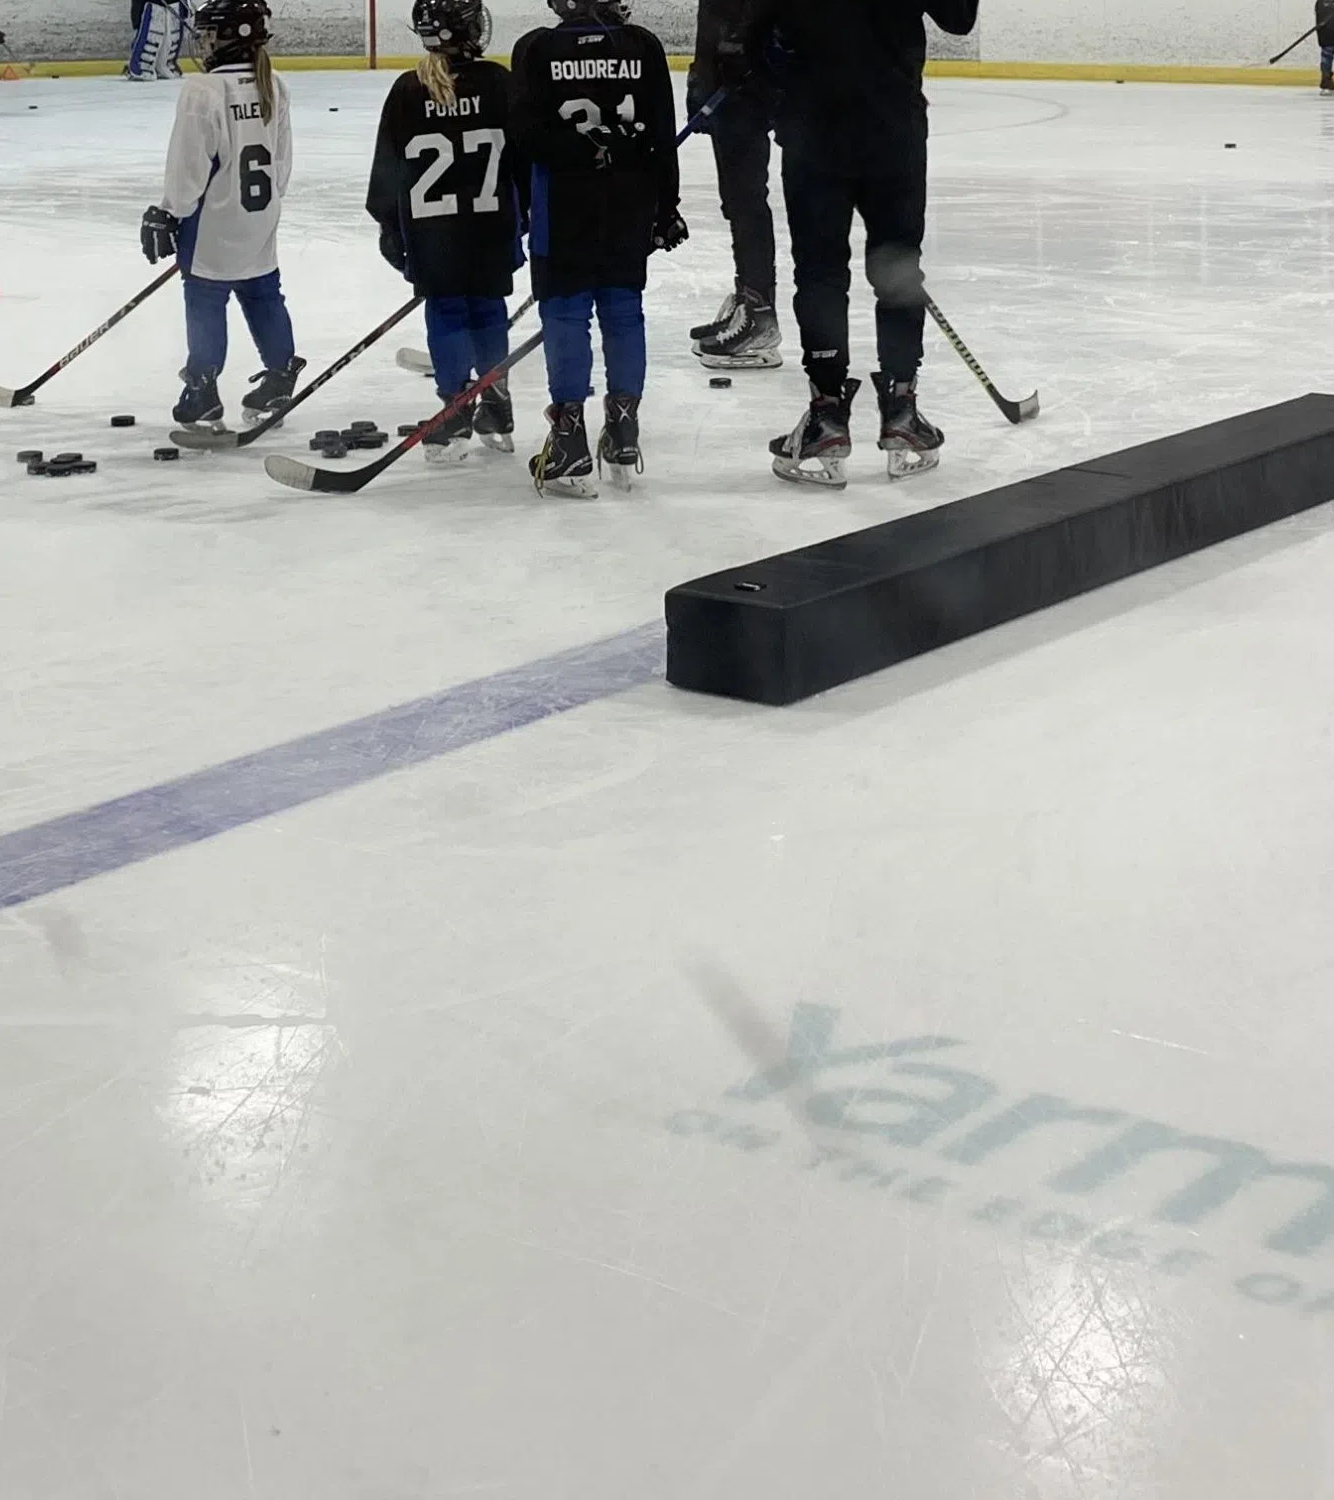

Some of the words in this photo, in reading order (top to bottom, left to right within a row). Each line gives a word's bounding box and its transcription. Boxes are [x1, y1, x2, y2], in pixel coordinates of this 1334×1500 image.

[551, 59, 642, 81] BOUDREAU
[230, 102, 264, 121] TALE
[425, 95, 480, 118] PURDY
[240, 144, 272, 212] 6
[404, 129, 506, 219] 27
